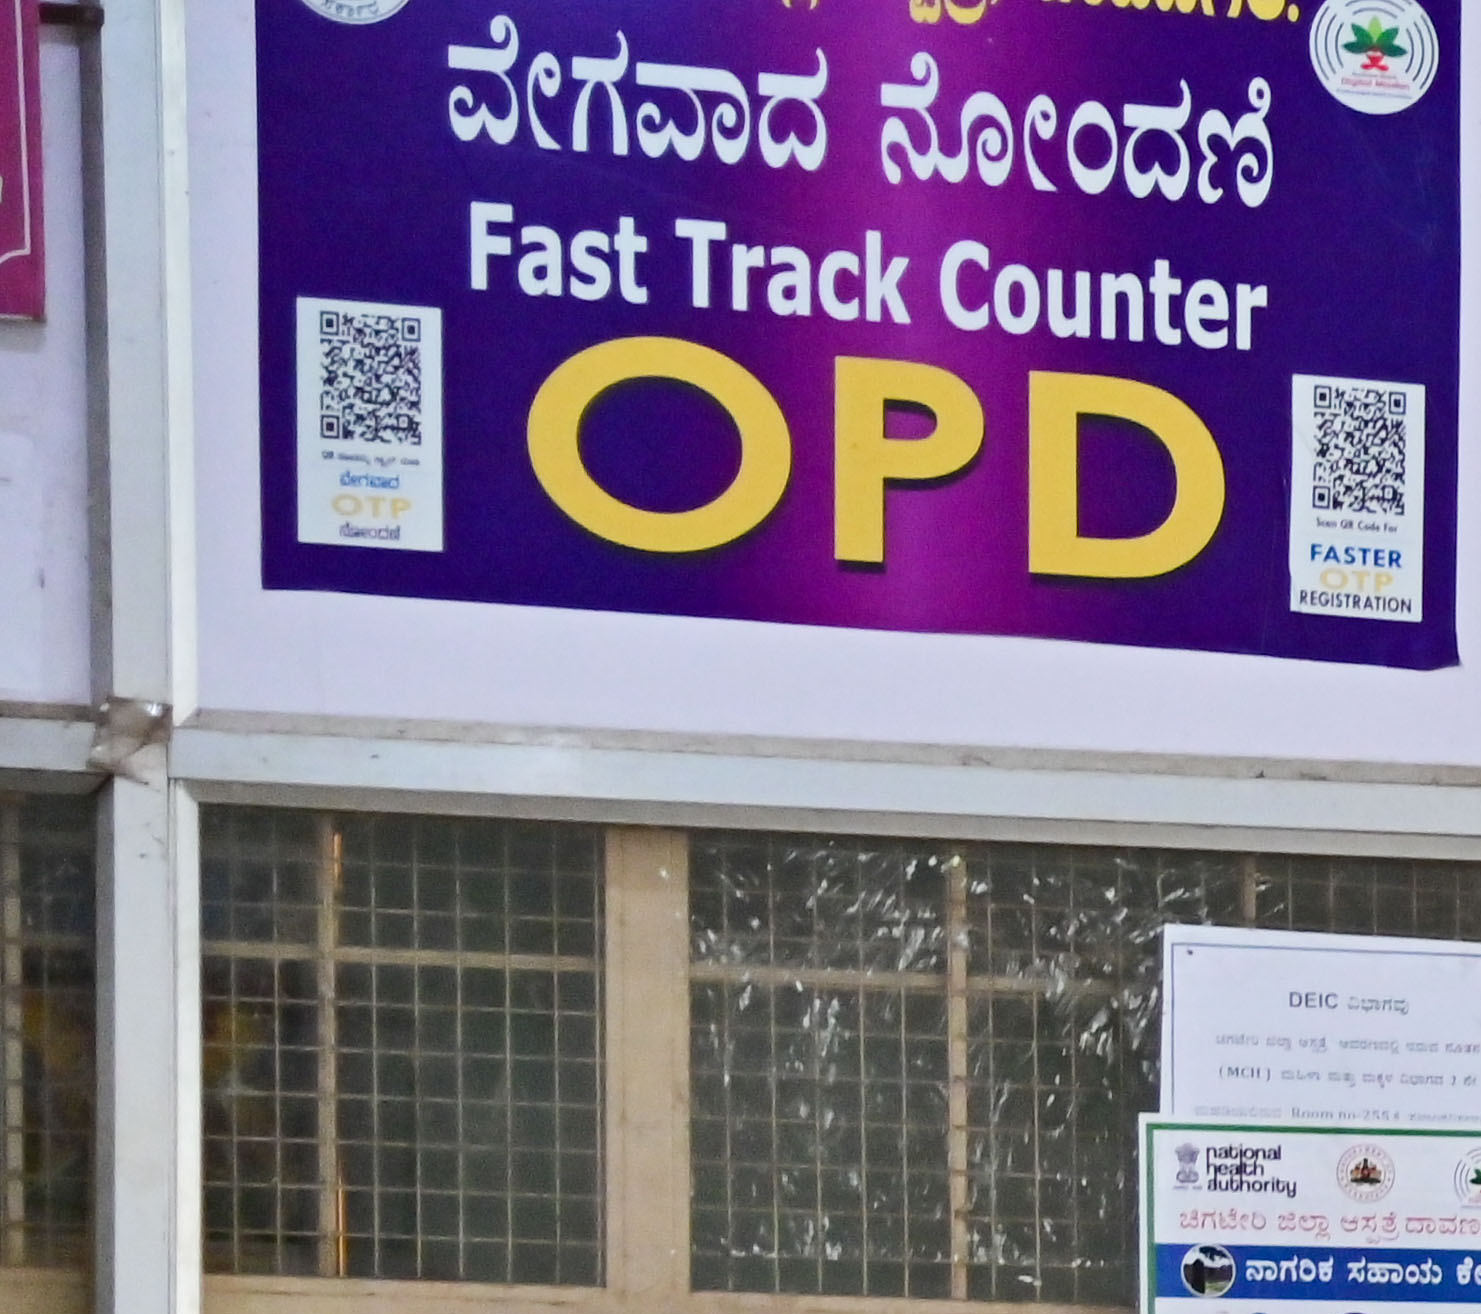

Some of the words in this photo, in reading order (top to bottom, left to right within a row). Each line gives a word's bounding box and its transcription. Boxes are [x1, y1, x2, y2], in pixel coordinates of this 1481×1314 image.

[447, 15, 830, 172] ವೇಗವಾದ
[881, 51, 1275, 207] ನೋಂದಣಿ
[470, 201, 648, 304] Fast
[675, 219, 909, 325] Track
[939, 239, 1268, 350] Counter
[526, 336, 1227, 582] OPD
[331, 493, 412, 518] OTP
[1340, 519, 1353, 530] QR
[1358, 522, 1380, 532] Code
[1310, 543, 1402, 568] FASTER
[1320, 567, 1394, 593] OTP
[1299, 590, 1412, 614] REGISTRATION
[1288, 991, 1338, 1010] DEIC
[1205, 1143, 1282, 1161] national
[1206, 1159, 1265, 1176] health
[1207, 1177, 1297, 1199] authority
[1245, 1256, 1334, 1283] ನಾಗರಿಕ
[1347, 1257, 1443, 1286] ಸಹಾಯ
